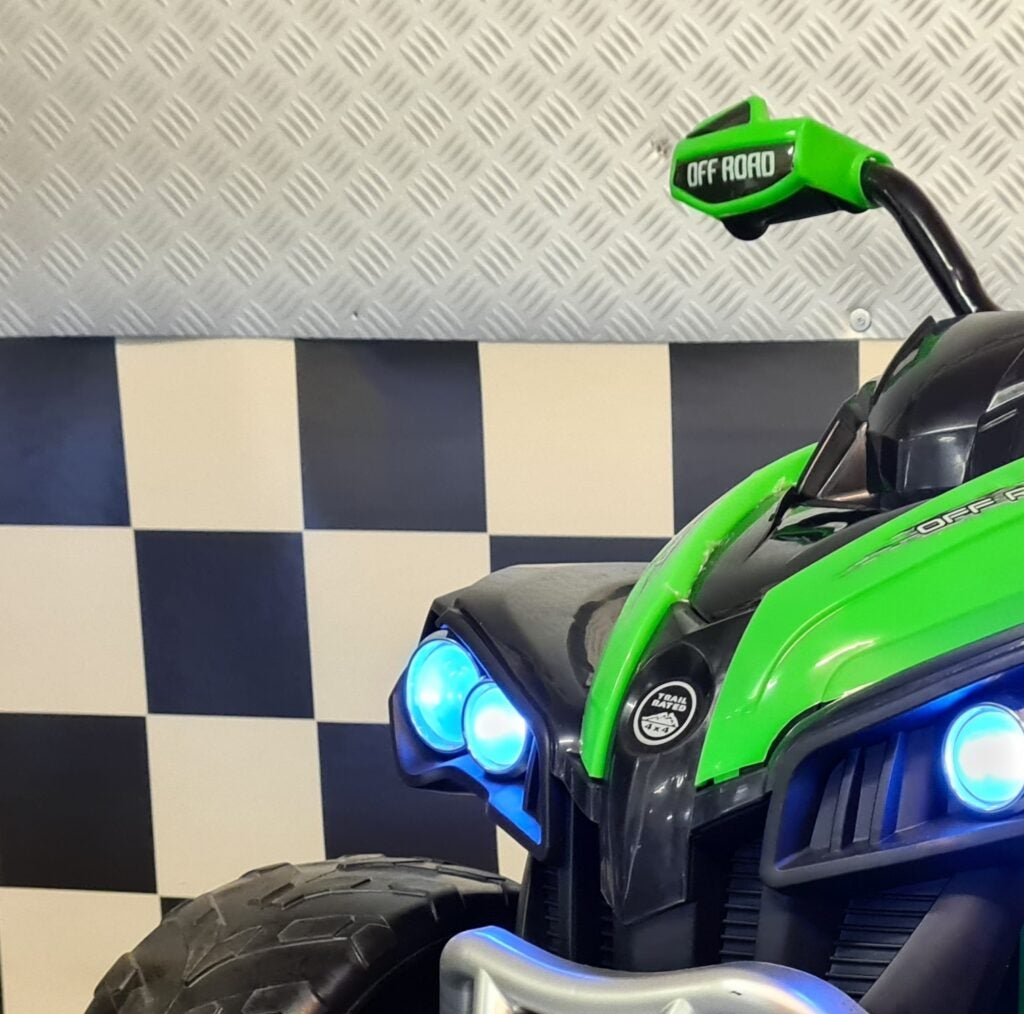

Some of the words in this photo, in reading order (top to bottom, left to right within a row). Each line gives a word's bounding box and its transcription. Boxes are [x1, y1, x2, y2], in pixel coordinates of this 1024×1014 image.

[687, 158, 719, 188] OFF
[721, 150, 775, 183] ROAD
[916, 497, 997, 535] OFF
[650, 699, 687, 712] RATED
[657, 692, 687, 704] TRAIL
